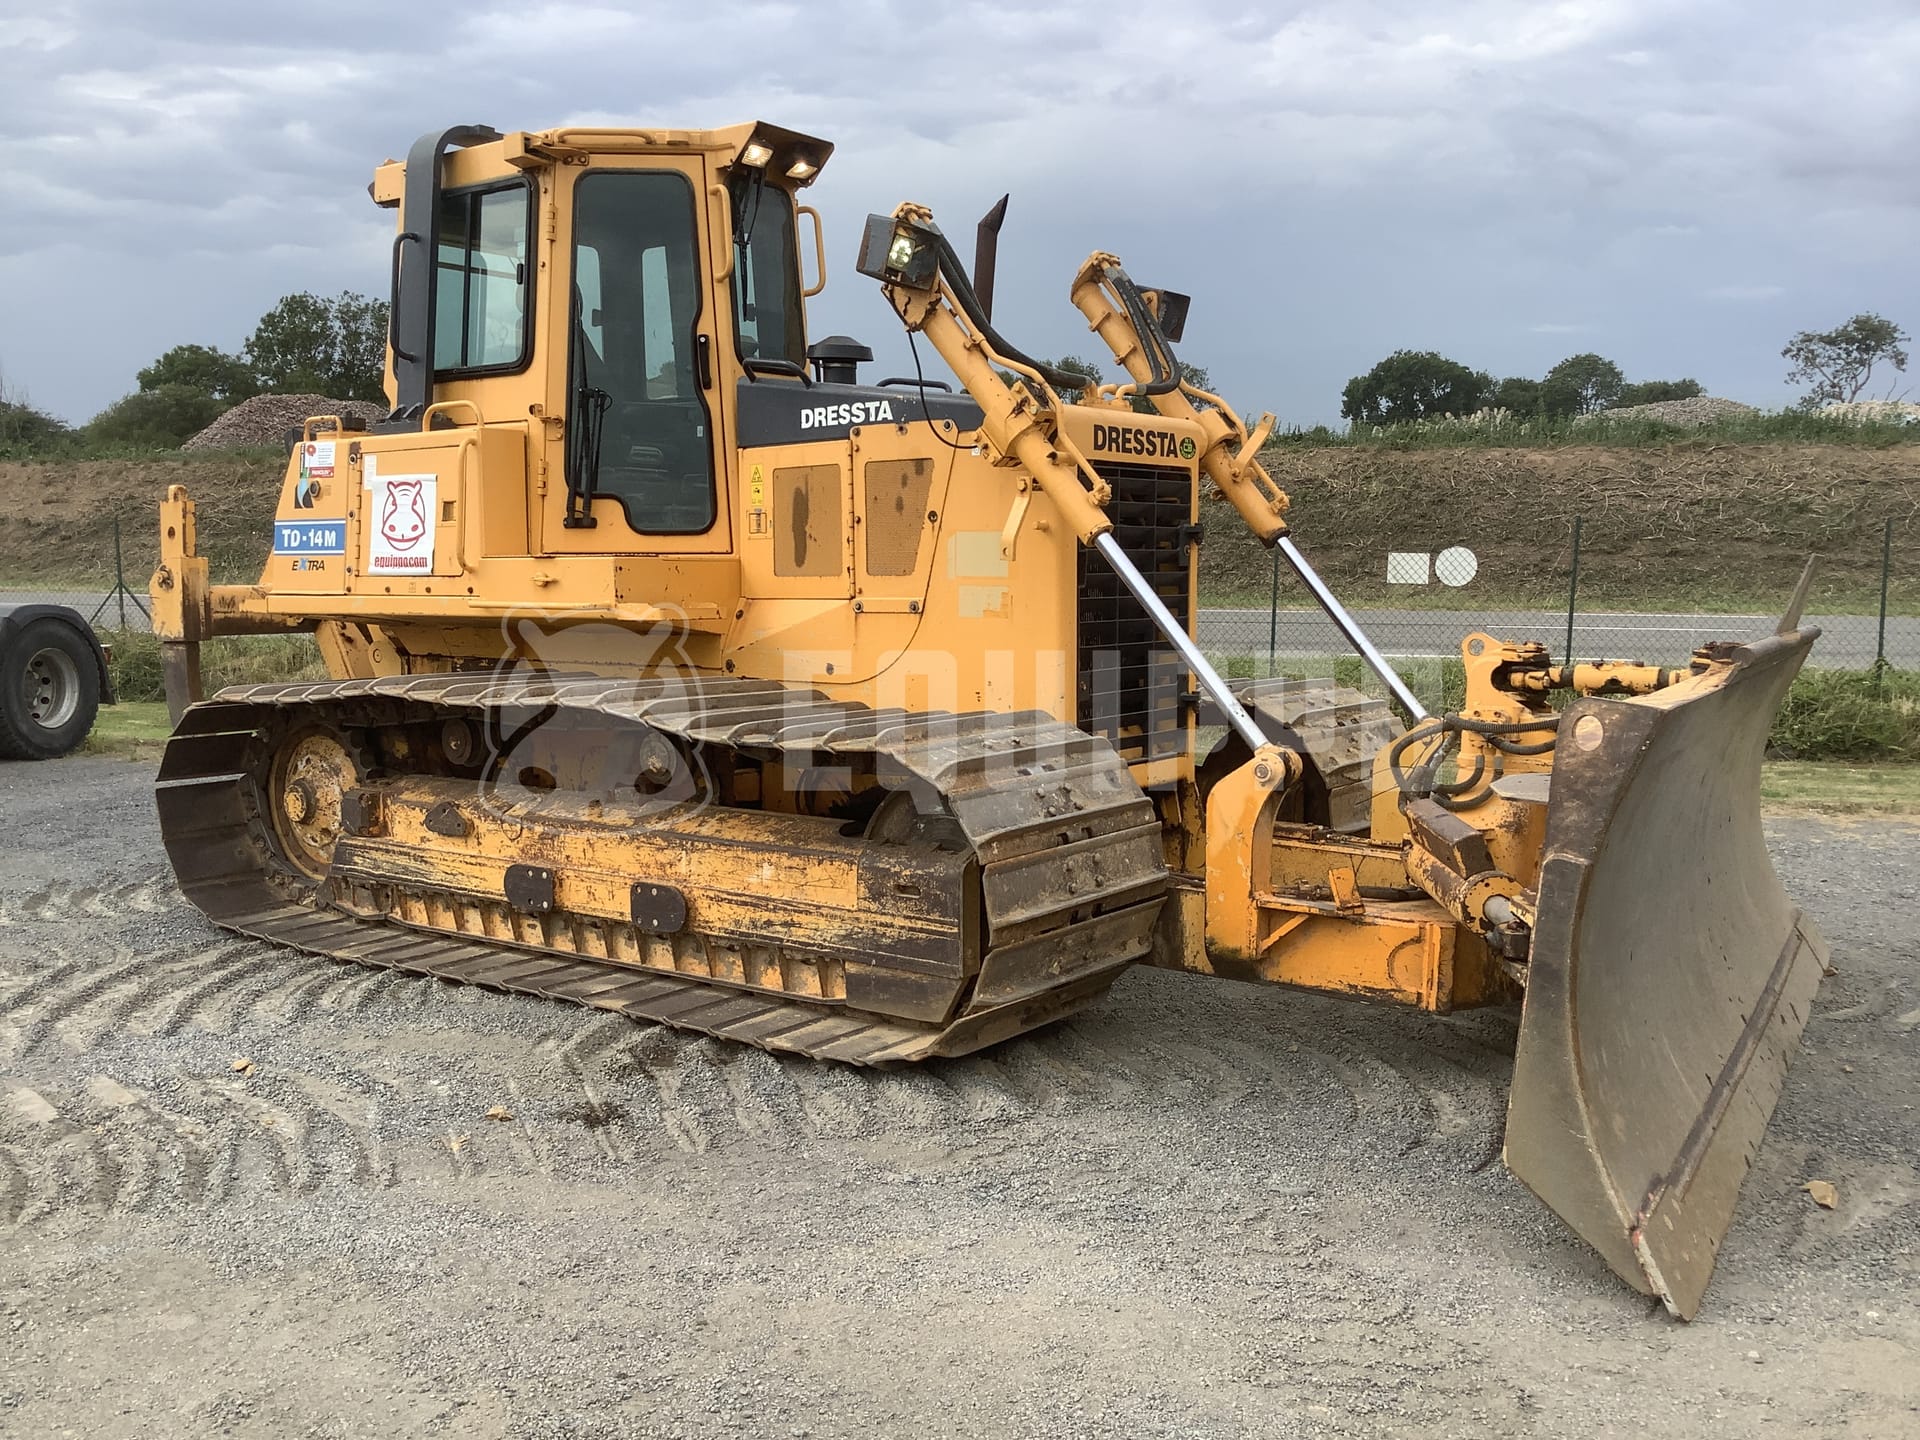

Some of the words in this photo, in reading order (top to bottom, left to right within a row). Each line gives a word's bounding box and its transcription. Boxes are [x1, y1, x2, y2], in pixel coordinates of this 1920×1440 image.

[800, 400, 894, 429] DRESSTA
[1093, 423, 1179, 458] DRESSTA
[291, 557, 326, 572] EXTRA
